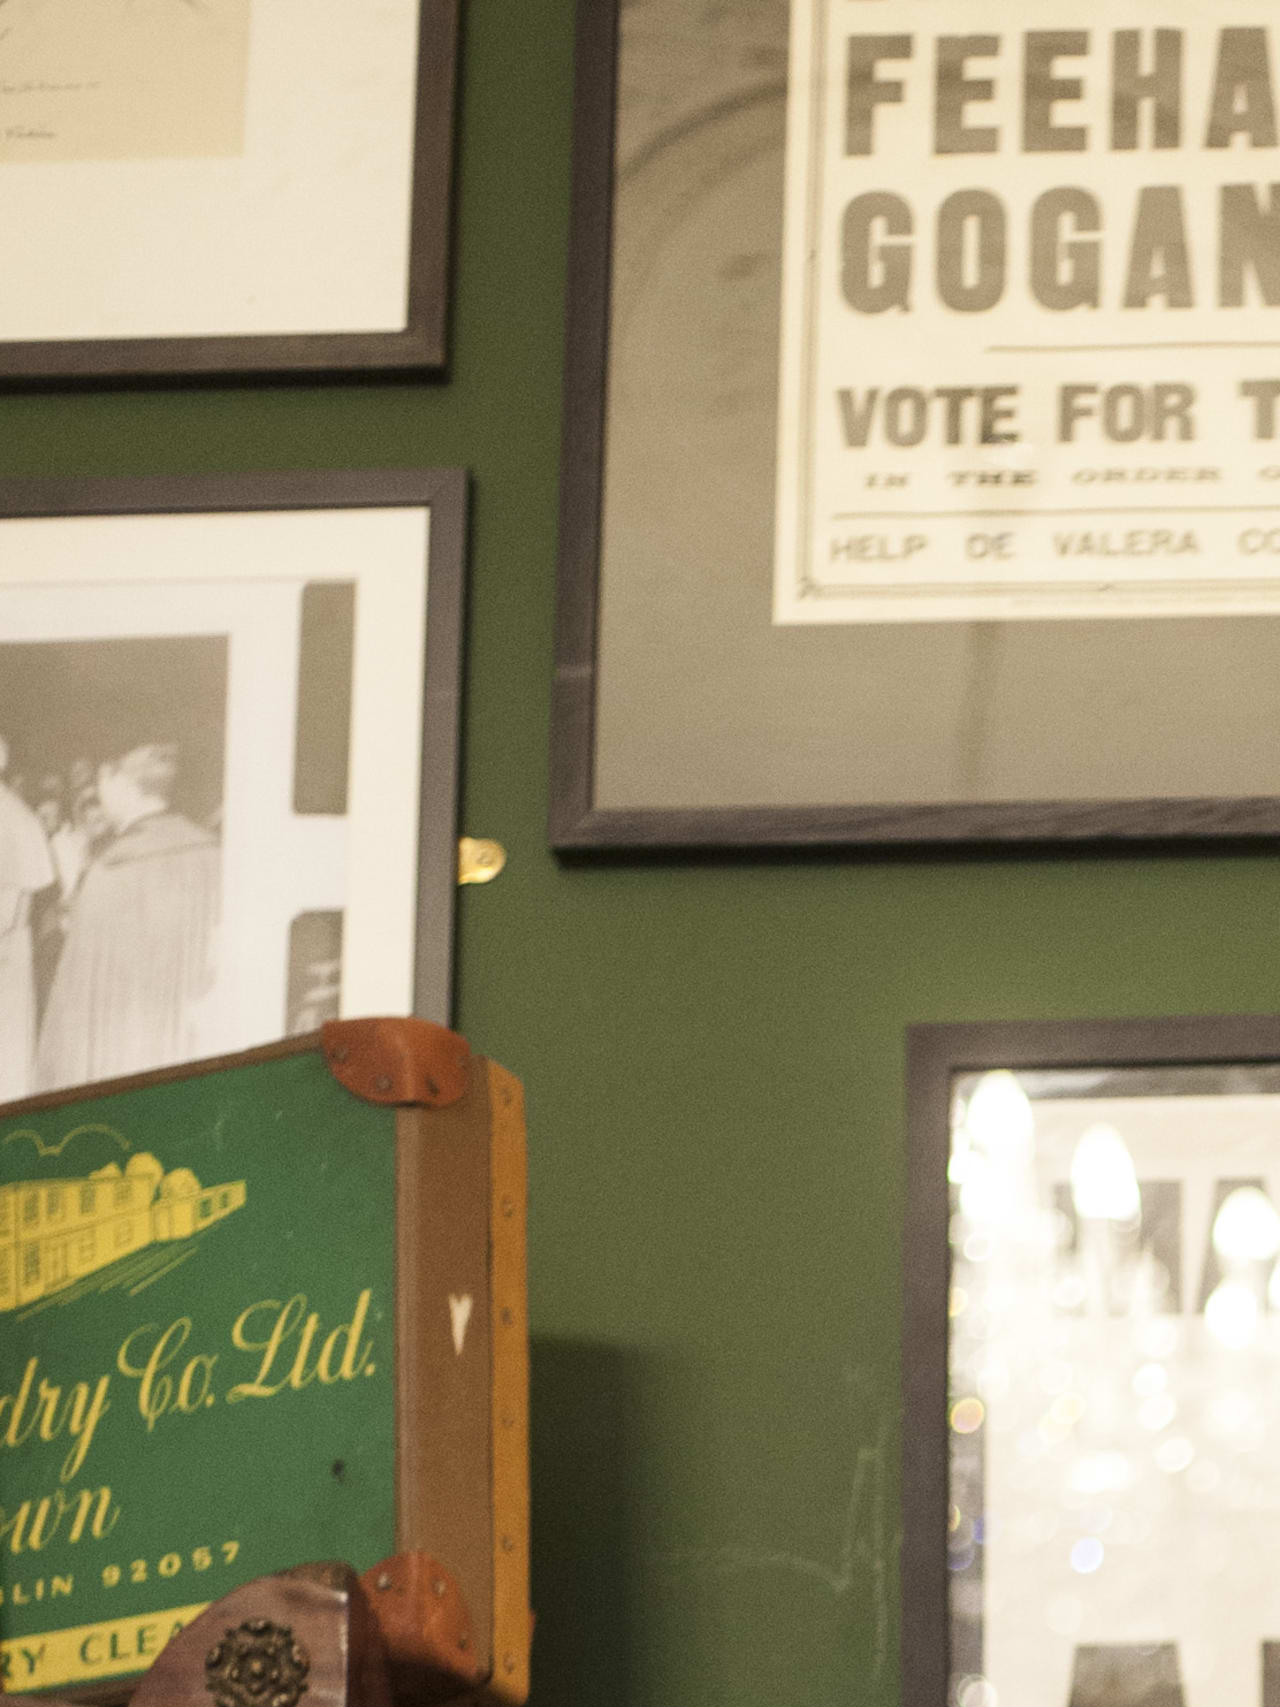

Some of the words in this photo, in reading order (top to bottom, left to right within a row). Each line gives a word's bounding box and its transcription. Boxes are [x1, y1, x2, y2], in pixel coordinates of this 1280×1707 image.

[835, 384, 1020, 448] VOTE
[1055, 382, 1196, 444] FOR
[950, 468, 1039, 488] THE
[828, 532, 928, 563] HELP
[963, 531, 1016, 561] DE
[1052, 528, 1201, 558] VALERA
[117, 1316, 218, 1433] Co.
[226, 1288, 377, 1405] Ltd.
